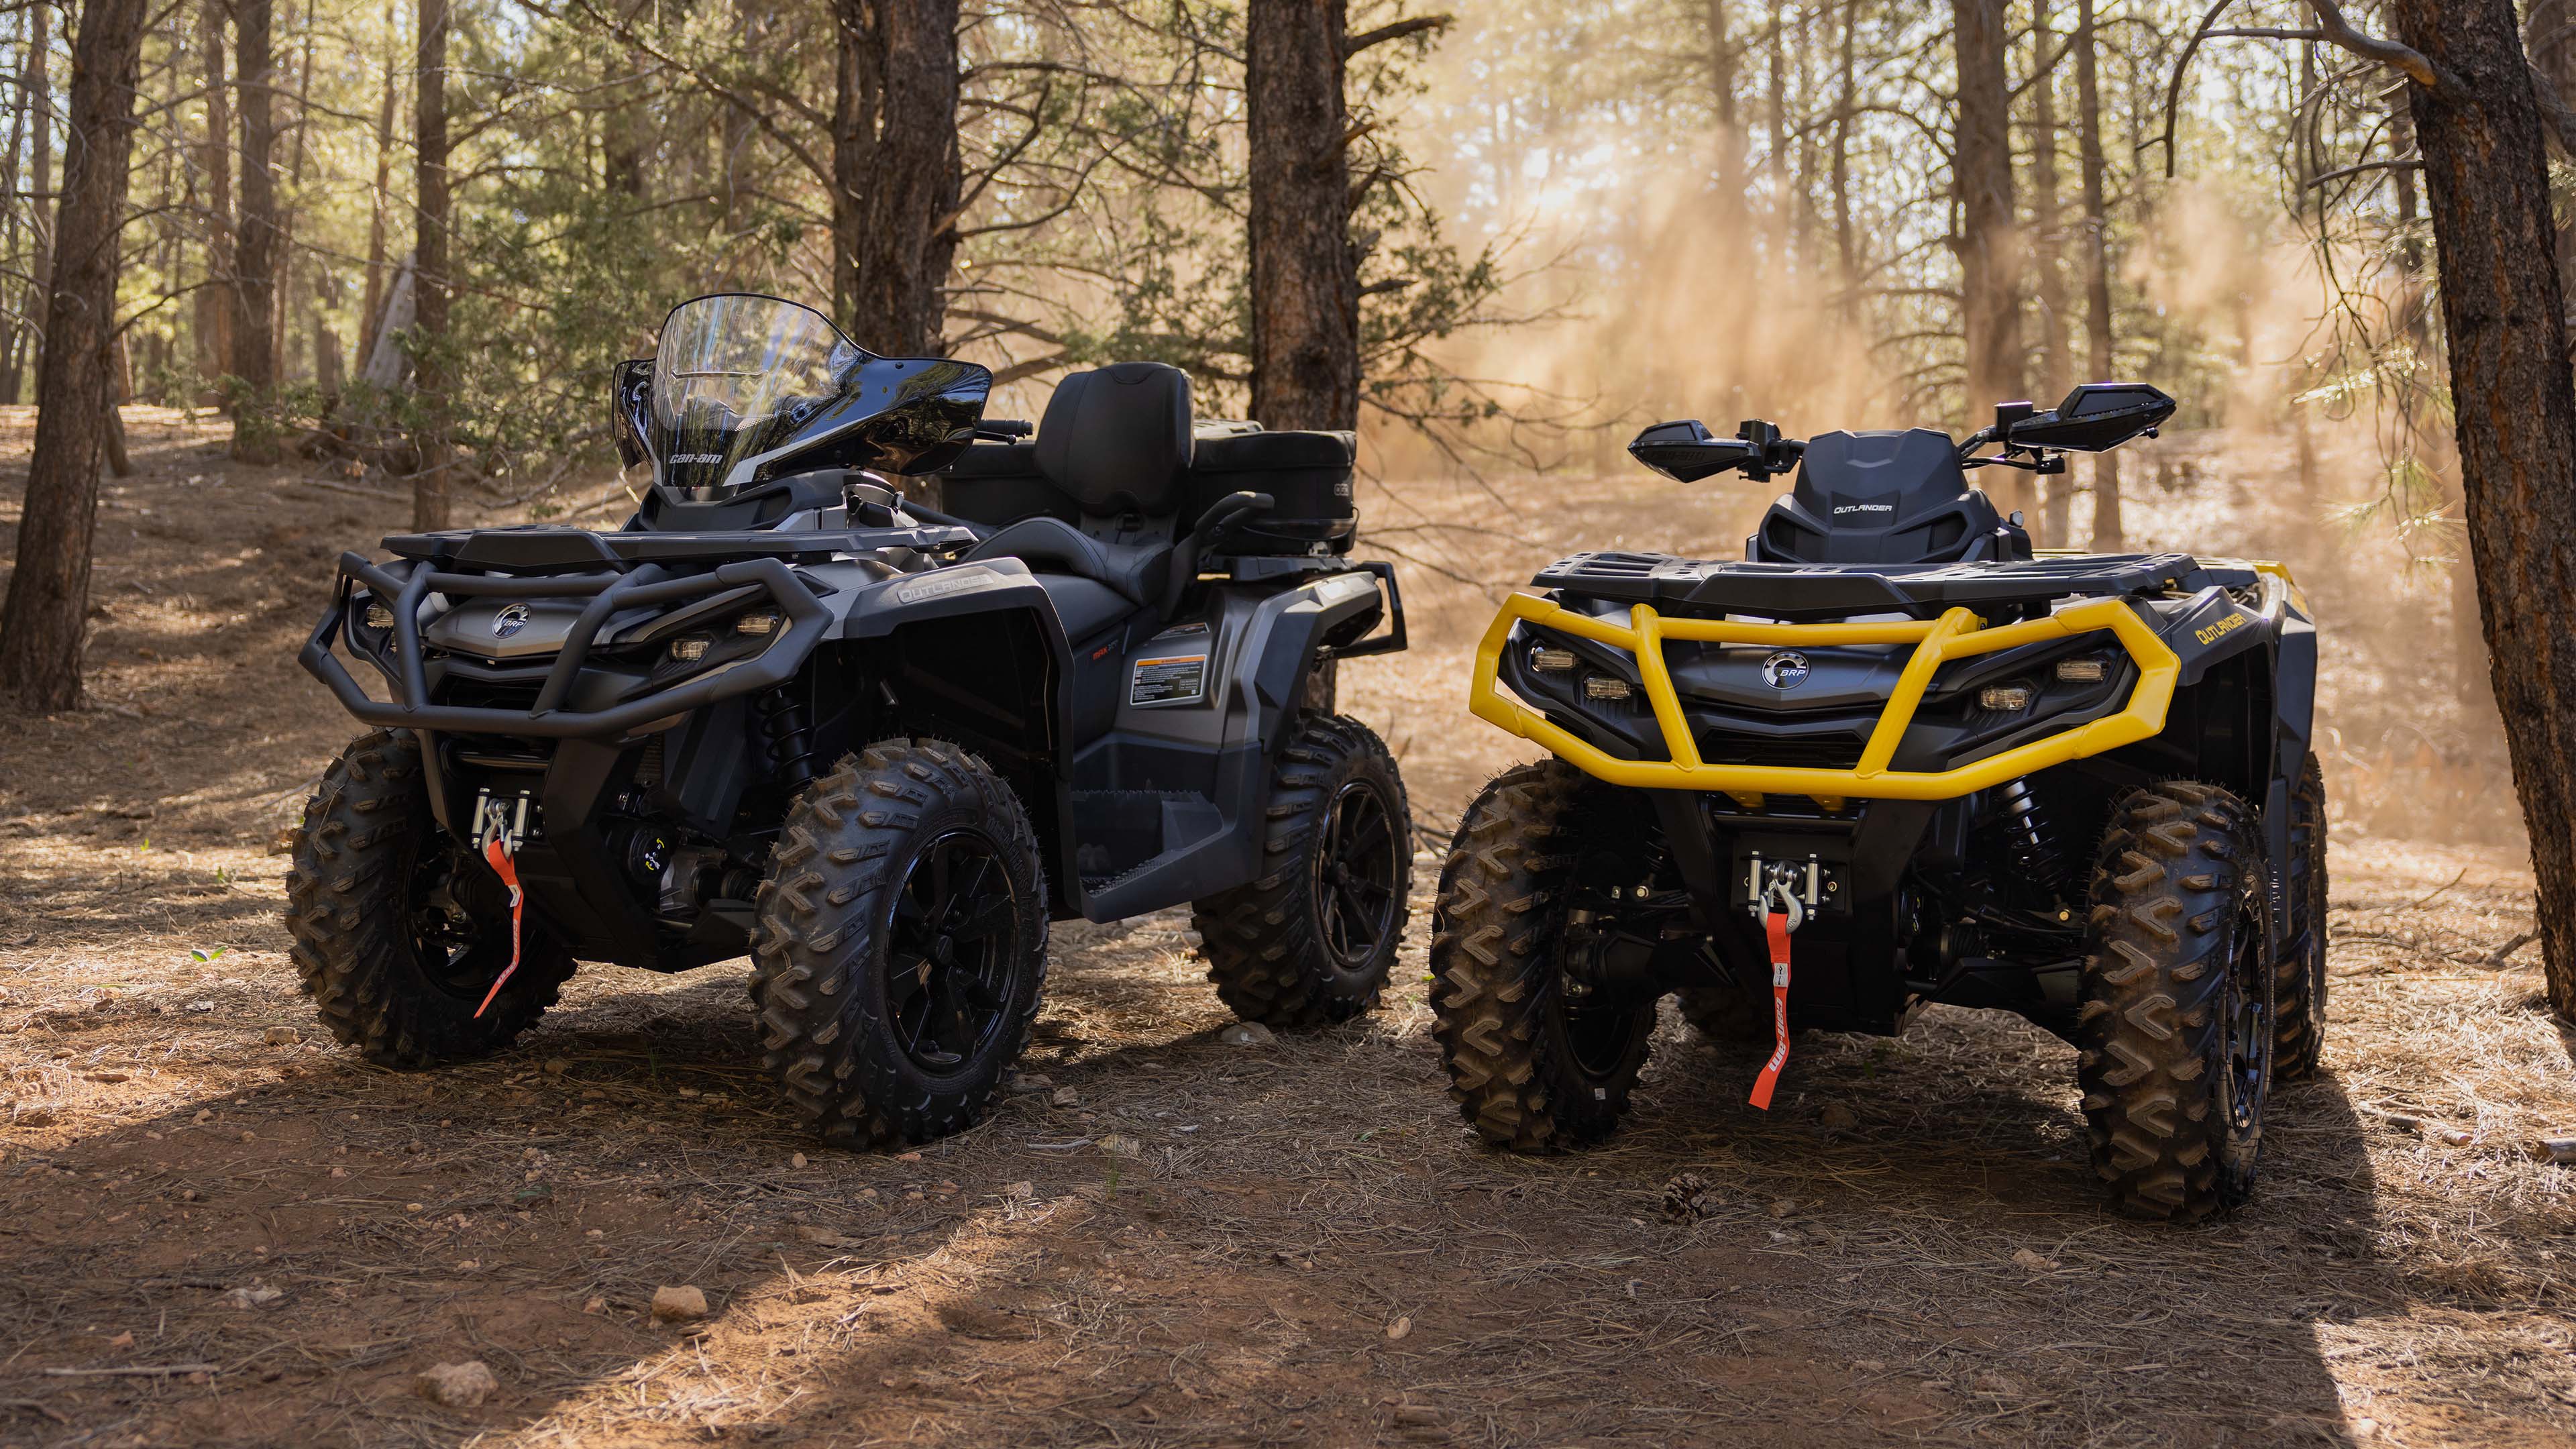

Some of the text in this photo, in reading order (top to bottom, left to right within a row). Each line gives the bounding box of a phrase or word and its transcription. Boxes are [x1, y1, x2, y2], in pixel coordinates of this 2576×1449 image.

[669, 453, 723, 464] can-am
[1833, 504, 1892, 514] OUTLANDER
[2195, 612, 2247, 645] OUTLANDER
[1768, 997, 1786, 1072] can-am
